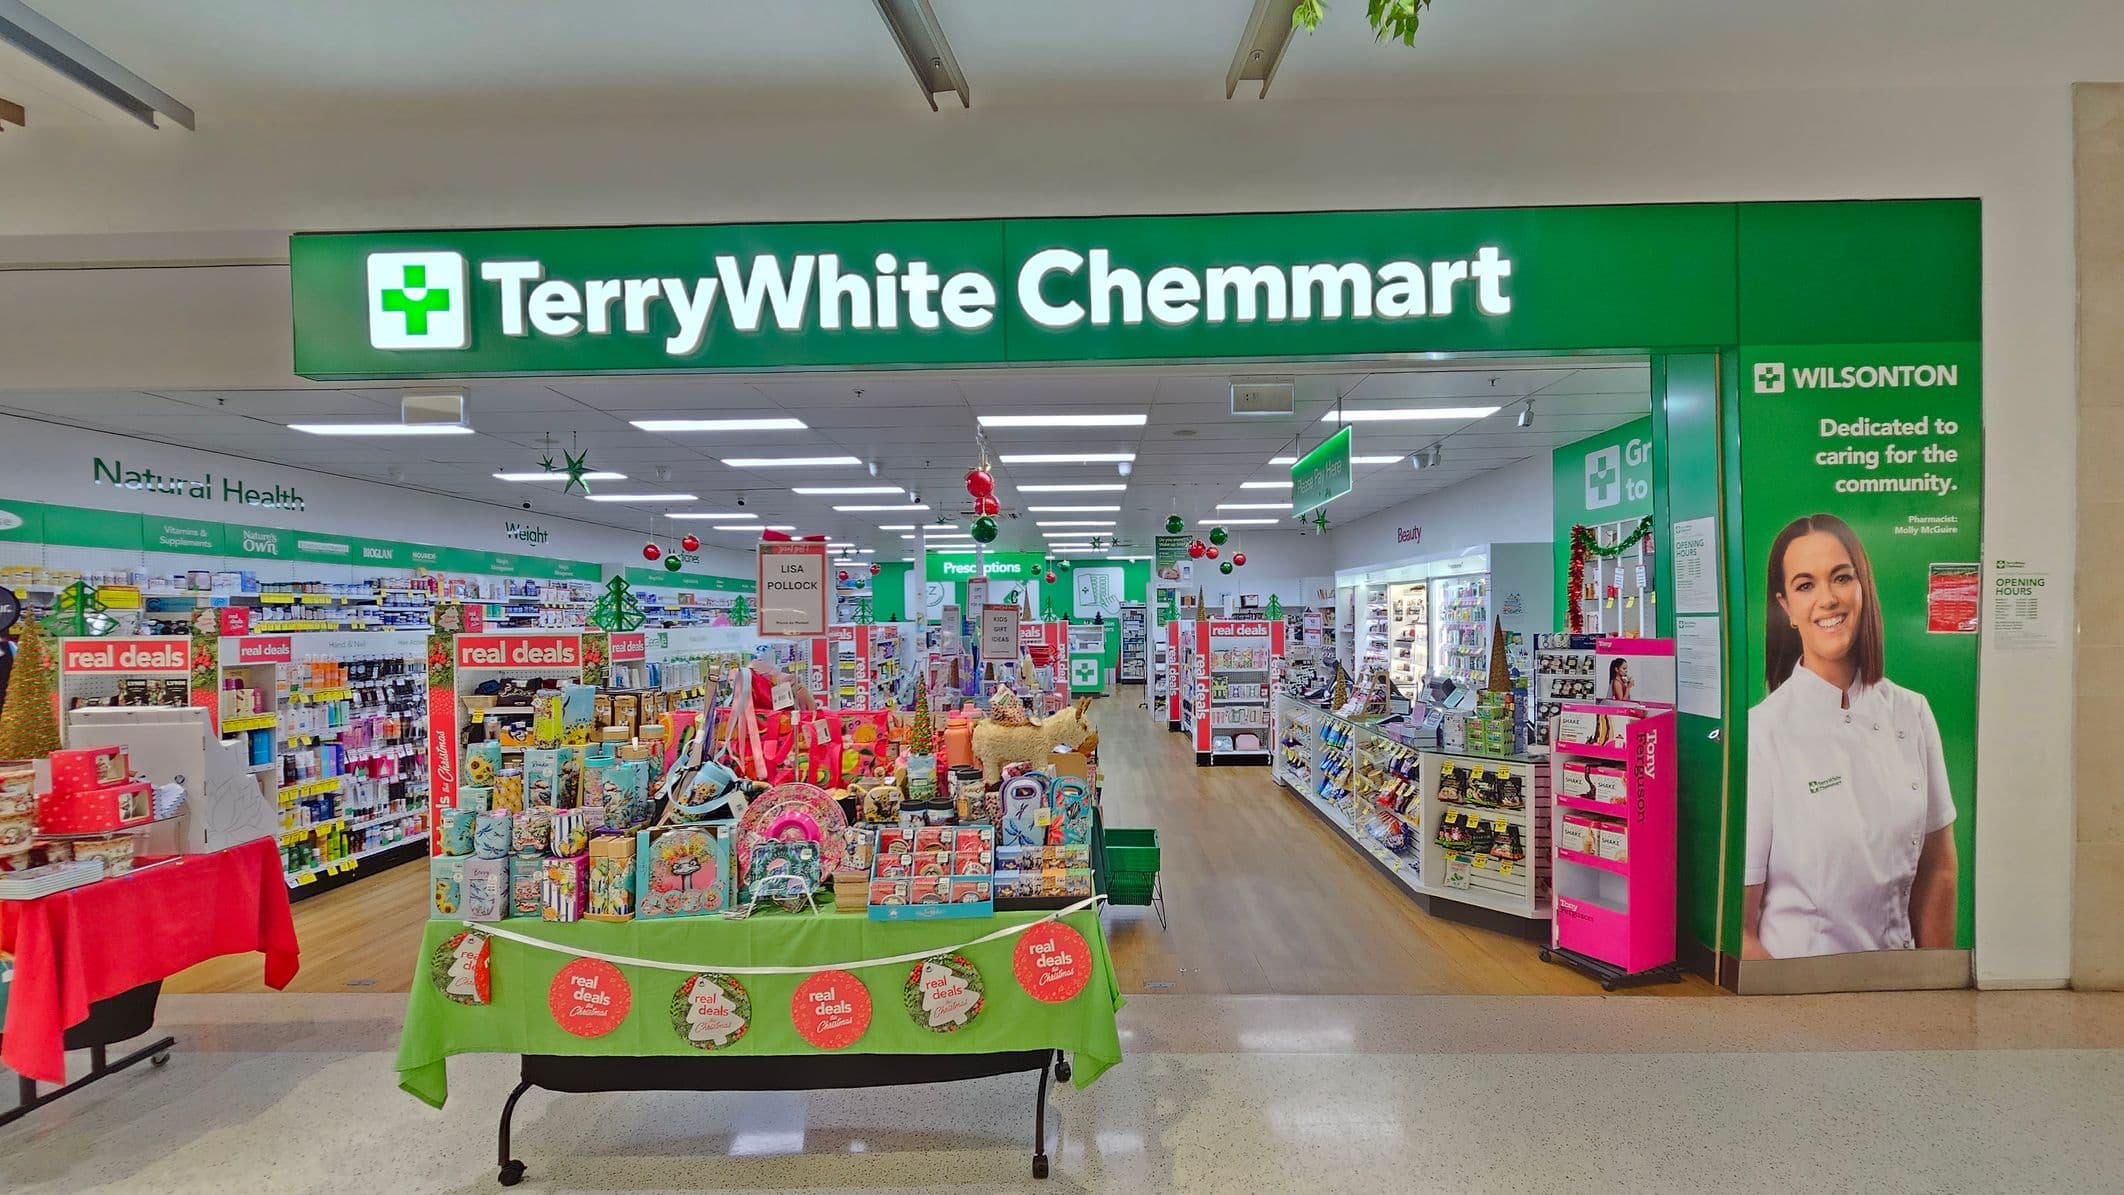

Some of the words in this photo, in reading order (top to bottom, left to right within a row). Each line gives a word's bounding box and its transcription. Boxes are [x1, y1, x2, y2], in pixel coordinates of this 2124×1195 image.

[481, 252, 997, 357] TerryWhite
[1017, 244, 1513, 328] Chemmart
[1792, 364, 1958, 389] WILSONTON
[1819, 415, 1929, 437] Dedicated
[1934, 418, 1959, 435] to
[1815, 446, 1880, 469] caring
[1885, 444, 1917, 464] for
[1921, 444, 1958, 463] the
[93, 456, 212, 500] Natural
[223, 477, 305, 512] Health
[1625, 478, 1648, 501] to
[1835, 473, 1958, 496] community.
[1908, 515, 1958, 524] Pharmacist:
[163, 525, 199, 537] Vitamins
[505, 521, 549, 546] Weight
[1397, 525, 1422, 544] Beauty
[1894, 526, 1918, 536] Molly
[1920, 525, 1958, 534] McGuire
[159, 536, 213, 548] Supplements
[242, 539, 279, 555] Own
[1676, 539, 1705, 550] OPENING
[363, 547, 393, 559] BIOGLAN
[781, 564, 805, 574] LISA
[943, 561, 1021, 575] Prescptions
[767, 581, 818, 590] POLLOCK
[1995, 578, 2046, 587] OPENING
[1995, 587, 2032, 596] HOURS
[1212, 624, 1235, 636] real
[1237, 623, 1268, 636] deals
[241, 642, 262, 657] real
[263, 641, 290, 656] deals
[462, 641, 507, 664] real
[512, 640, 575, 664] deals
[612, 641, 627, 652] real
[626, 640, 644, 652] deals
[68, 645, 114, 668] real
[119, 643, 185, 668] deals
[1168, 645, 1178, 665] real
[856, 657, 866, 679] real
[1195, 653, 1206, 679] real
[812, 664, 824, 692] real
[1168, 667, 1178, 697] deals
[1195, 681, 1206, 720] deals
[436, 730, 454, 783] Christmas
[1645, 728, 1658, 780] Tony
[1565, 776, 1583, 785] SHAKE
[1598, 782, 1617, 790] SHAKE
[1634, 732, 1647, 824] Ferguson
[1564, 828, 1582, 838] SHAKE
[1602, 837, 1621, 847] SHAKE
[1560, 899, 1578, 912] Tony
[1029, 937, 1055, 955] real
[460, 951, 480, 961] rea
[1036, 950, 1073, 968] deals
[570, 975, 599, 989] real
[925, 975, 947, 990] real
[1039, 967, 1075, 986] Christmas
[573, 987, 611, 1006] deals
[694, 993, 717, 1004] real
[808, 987, 836, 1003] real
[932, 985, 963, 1000] deals
[569, 1005, 608, 1017] Christmas
[698, 1004, 729, 1017] deals
[815, 1000, 852, 1016] deals
[933, 998, 968, 1019] Christmas
[694, 1021, 732, 1034] Christmas
[816, 1016, 853, 1034] Christmas
